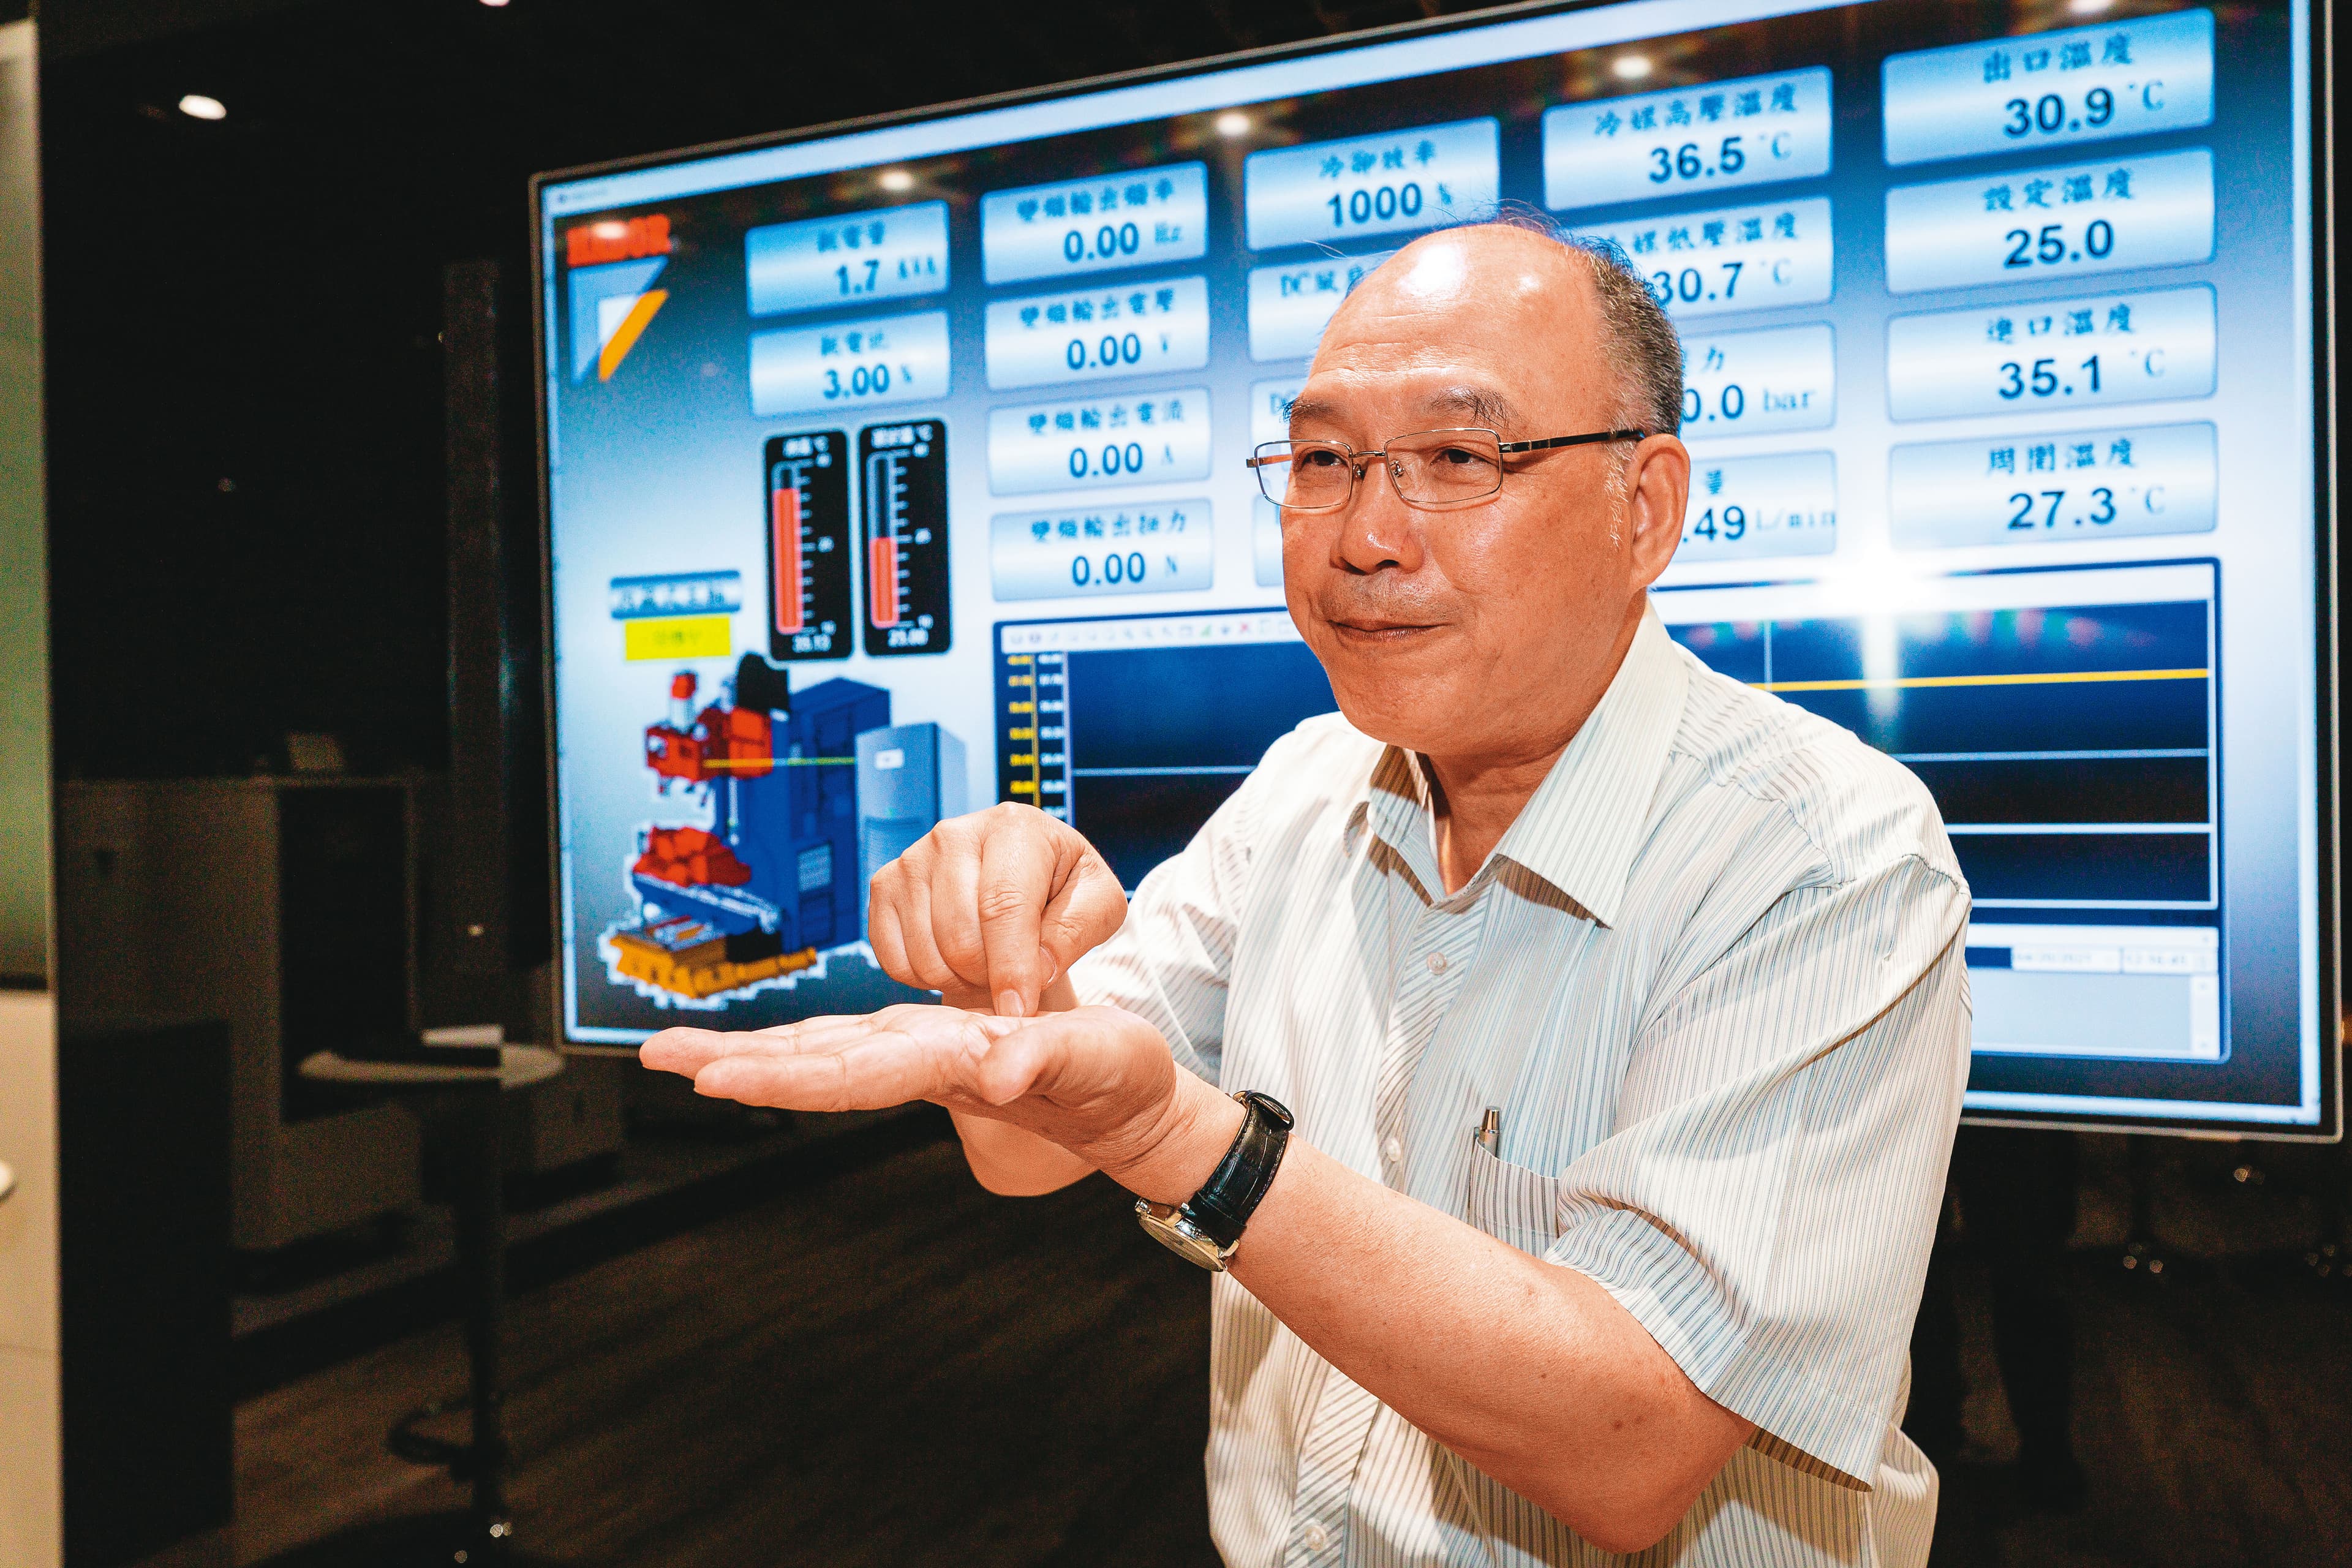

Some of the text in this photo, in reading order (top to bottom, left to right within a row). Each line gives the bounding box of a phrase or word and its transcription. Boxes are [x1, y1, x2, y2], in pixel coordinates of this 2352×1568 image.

[1983, 32, 2132, 83] 出口溫度
[2003, 88, 2114, 138] 30.9
[1649, 136, 1744, 183] 36.5
[1328, 183, 1422, 227] 1000
[1983, 167, 2134, 211] 設定溫度
[1064, 222, 1139, 262] 0.00
[1611, 211, 1798, 254] 媒低壓溫度
[2003, 220, 2114, 269] 25.0
[835, 260, 880, 296] 1.7
[1653, 262, 1743, 306] 30.7
[1067, 333, 1140, 369] 0.00
[823, 364, 891, 400] 3.00
[1999, 355, 2100, 399] 35.1
[1763, 389, 1815, 412] bar
[1069, 443, 1143, 478] 0.00
[1683, 505, 1746, 542] .49
[2008, 488, 2116, 529] 27.3
[1072, 552, 1145, 586] 0.00
